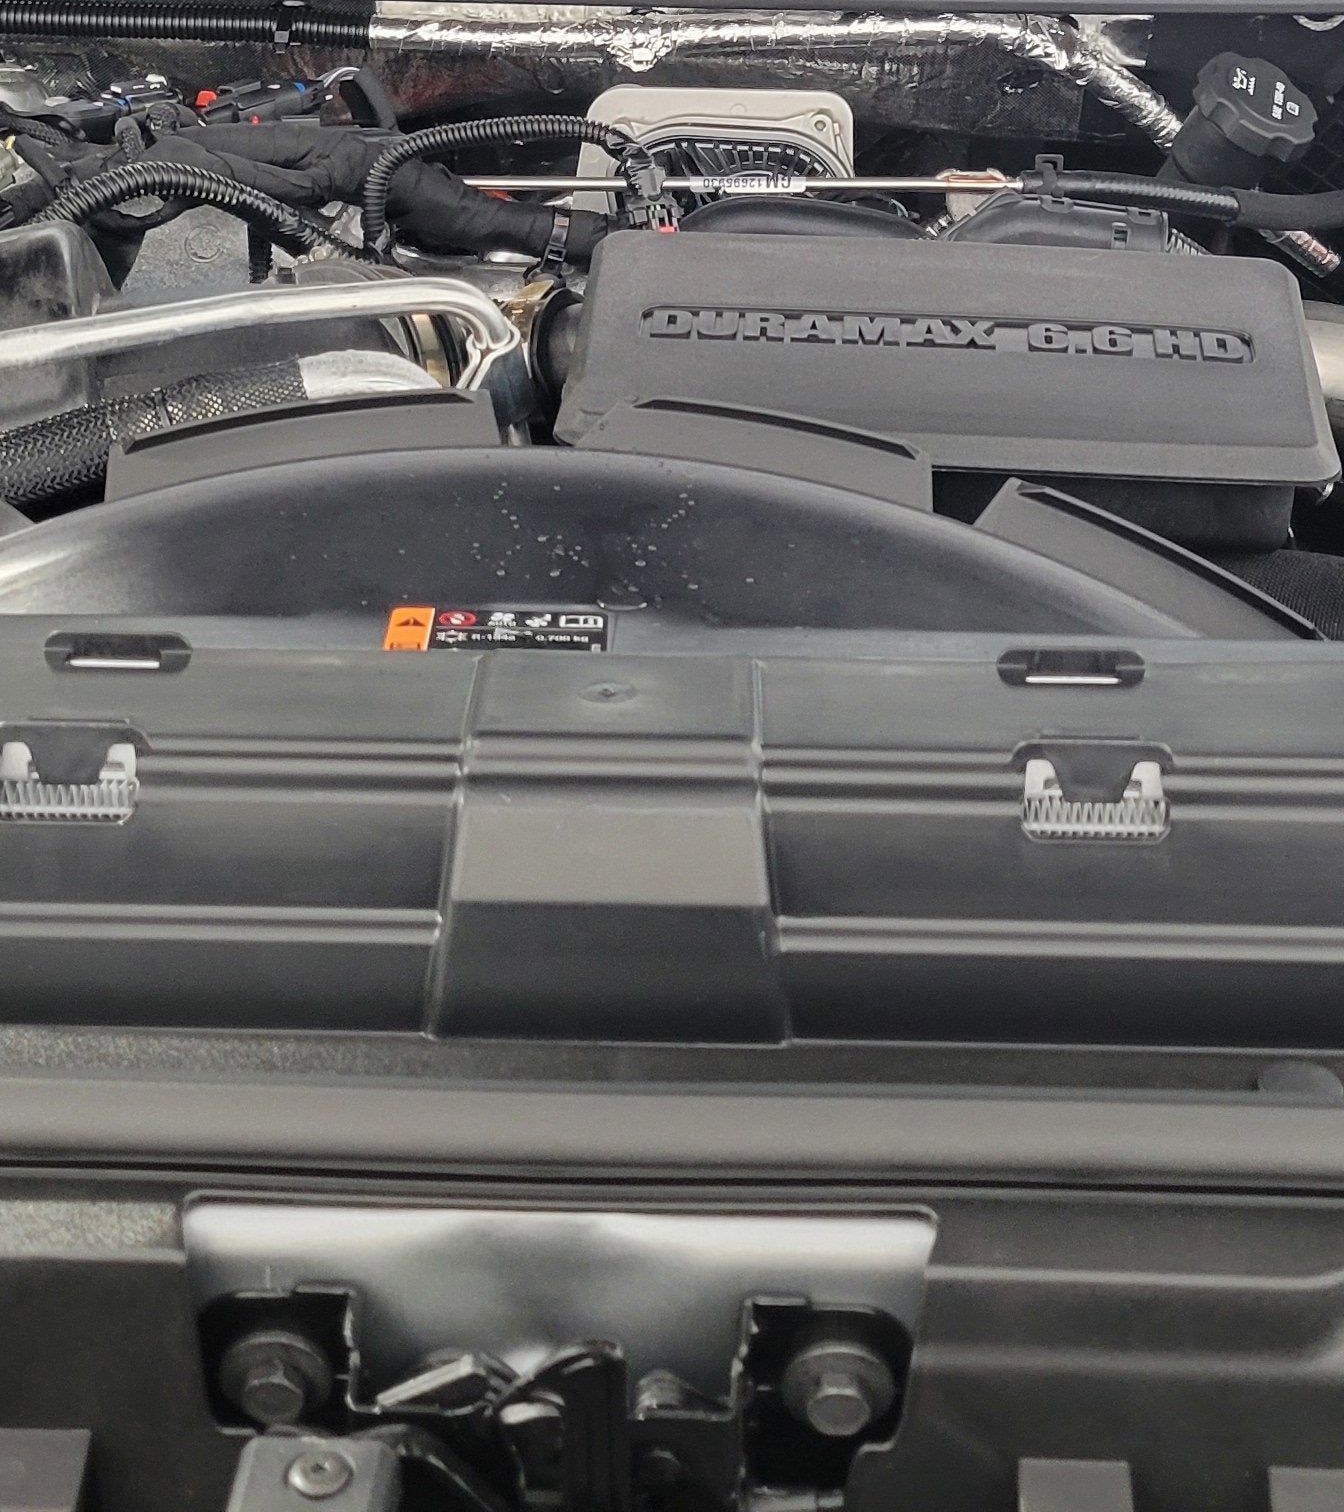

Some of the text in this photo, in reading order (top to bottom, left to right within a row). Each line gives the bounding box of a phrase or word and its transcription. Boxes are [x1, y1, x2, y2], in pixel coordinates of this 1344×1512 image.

[650, 309, 1245, 364] DURAMAX 6.6 HD
